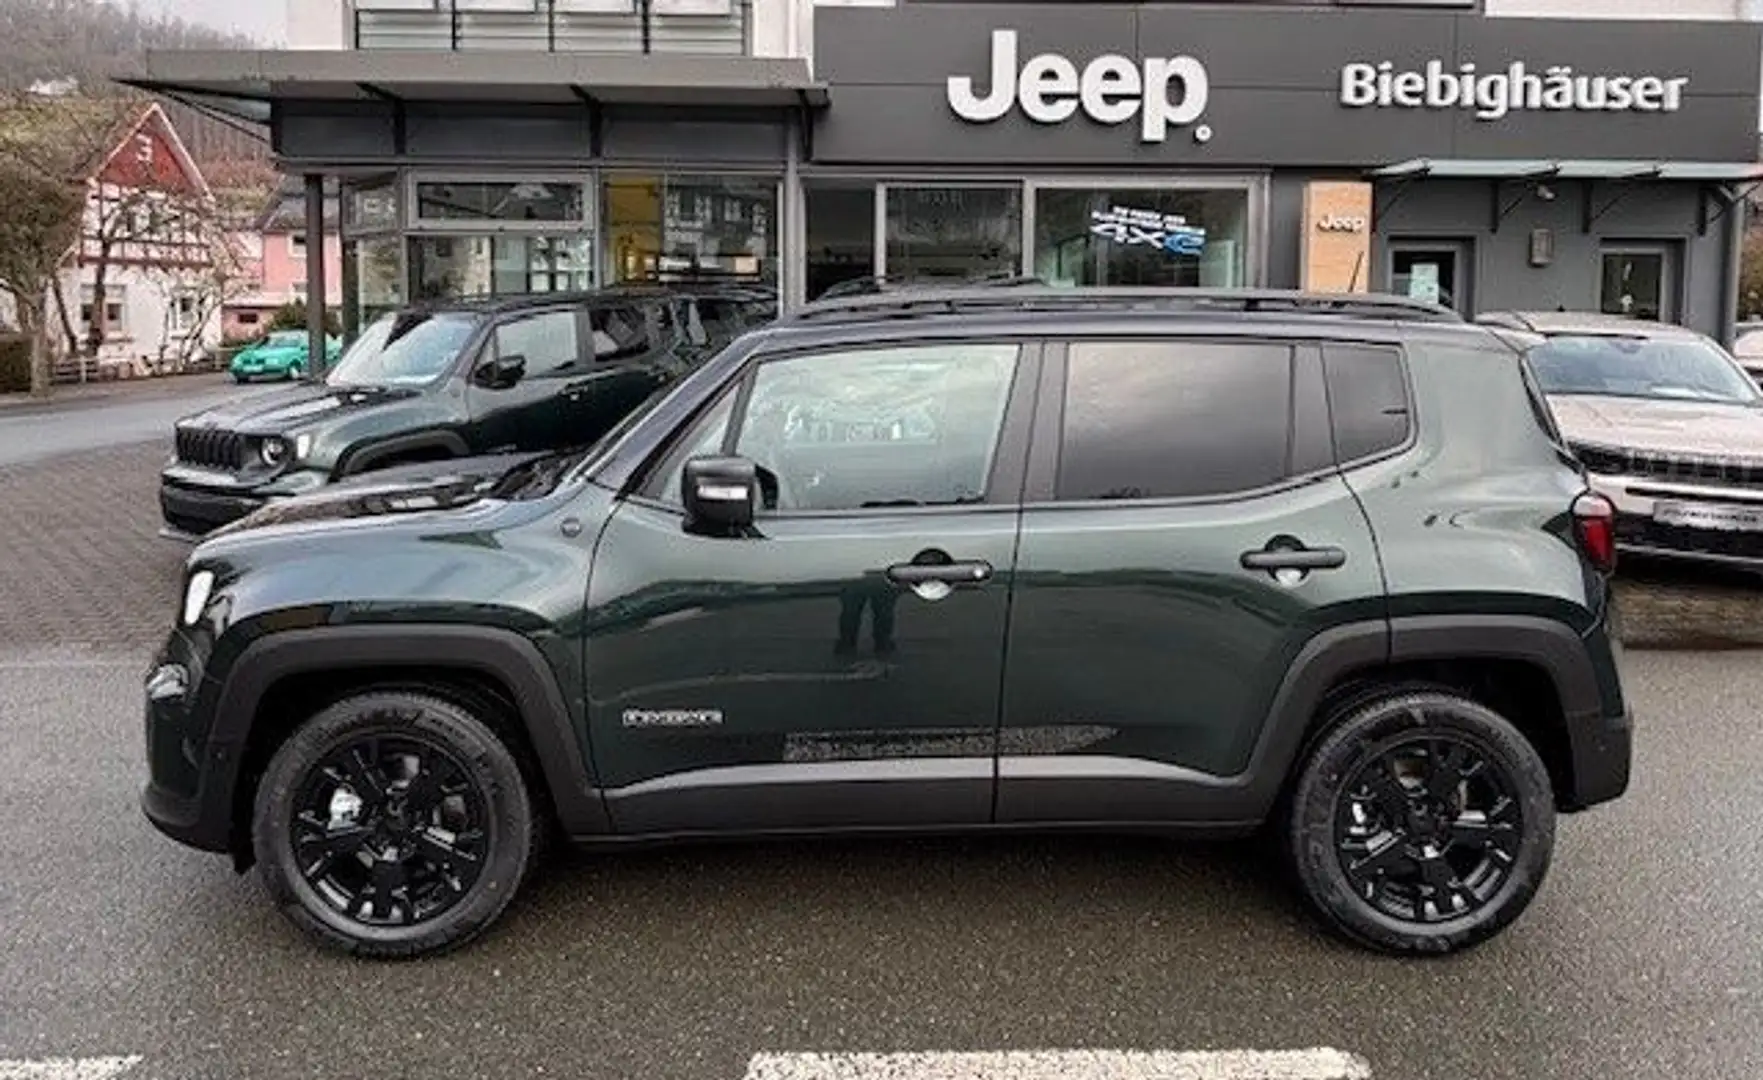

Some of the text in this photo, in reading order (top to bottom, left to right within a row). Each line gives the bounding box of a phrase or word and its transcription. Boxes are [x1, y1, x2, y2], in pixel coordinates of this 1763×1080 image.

[947, 29, 1209, 142] Jeep
[1340, 59, 1689, 120] Biebighäuser
[1319, 213, 1365, 234] Jeep
